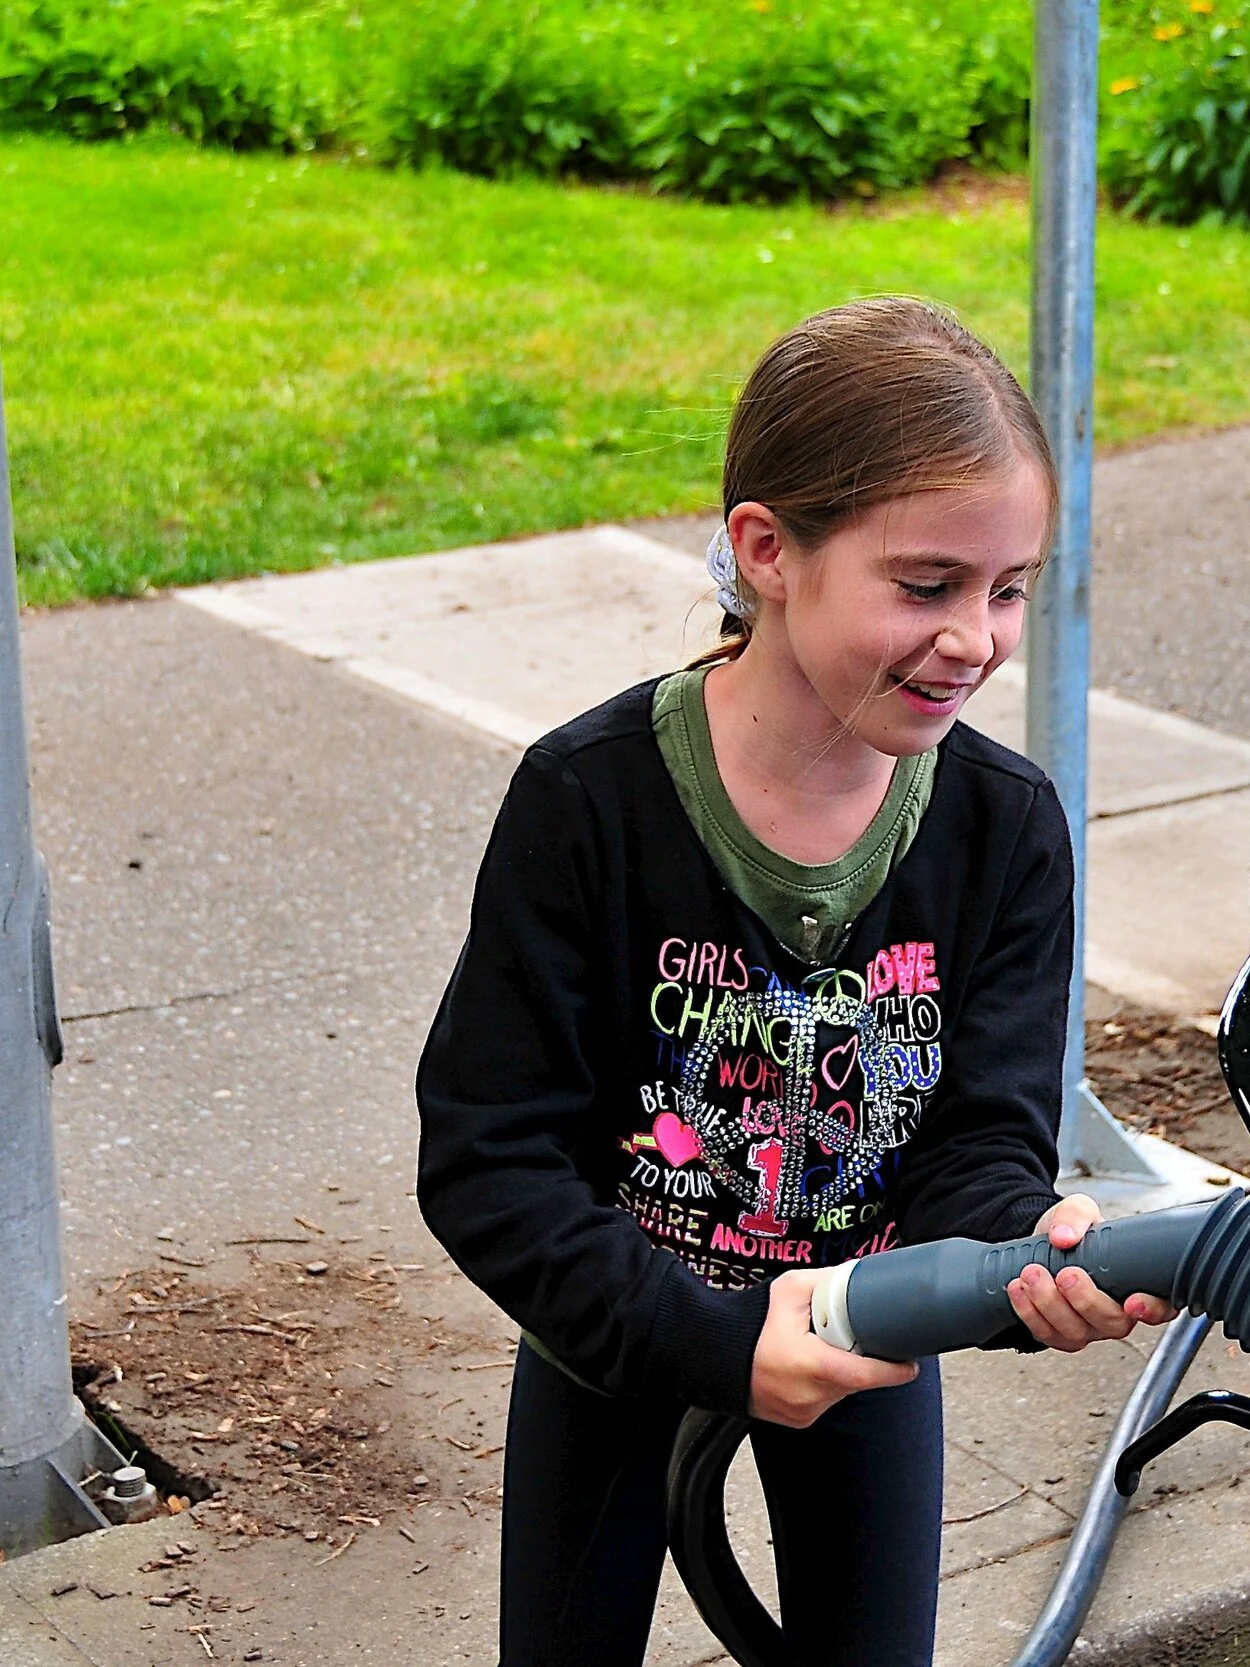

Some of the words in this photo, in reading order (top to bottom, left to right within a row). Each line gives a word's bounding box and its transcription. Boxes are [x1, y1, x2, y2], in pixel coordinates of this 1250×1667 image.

[658, 937, 749, 991] GIRLS
[866, 941, 941, 1005] LOVE
[640, 1079, 669, 1113] BE
[857, 1041, 943, 1102] YOU
[631, 1155, 661, 1188] TO
[663, 1167, 718, 1200] YOUR
[738, 1137, 790, 1238] 1
[710, 1222, 813, 1264] ANOTHER
[813, 1204, 857, 1233] ARE
